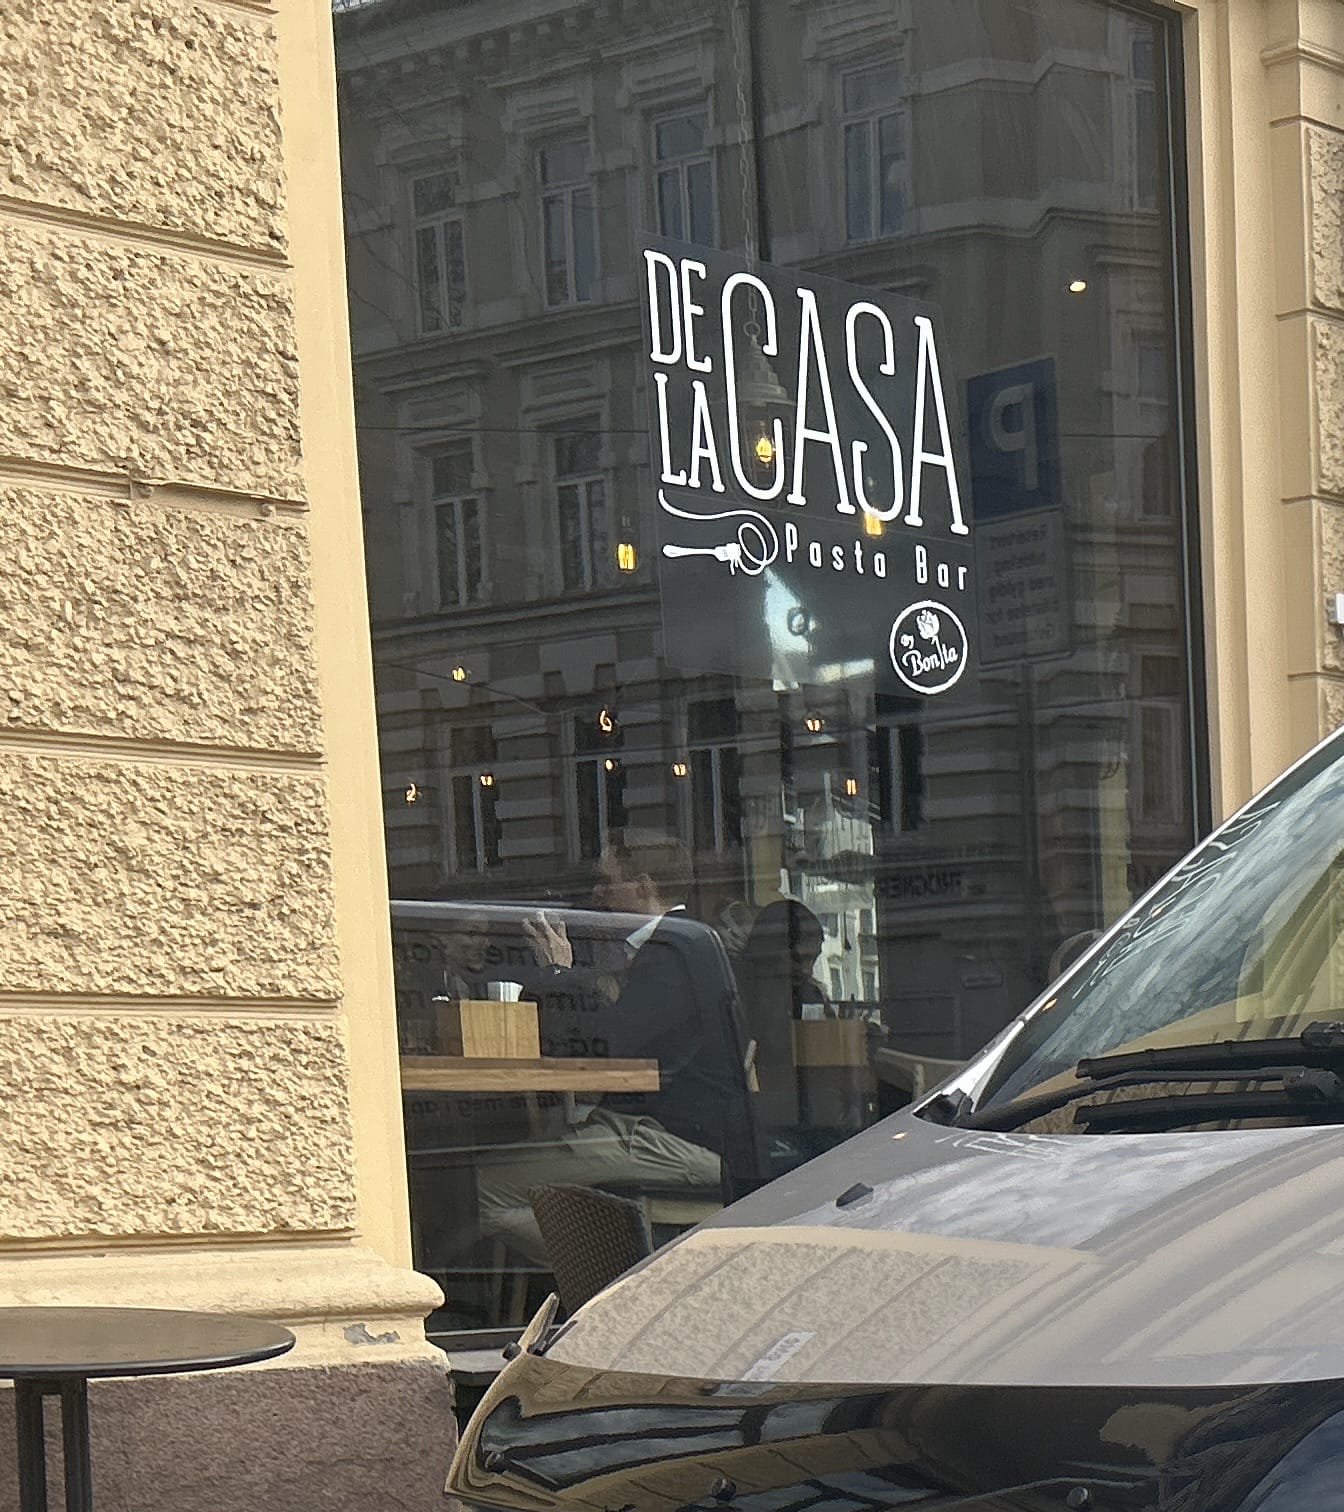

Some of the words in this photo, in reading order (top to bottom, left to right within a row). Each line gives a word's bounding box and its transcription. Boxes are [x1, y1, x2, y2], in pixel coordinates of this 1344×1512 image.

[644, 249, 712, 372] DE
[654, 373, 725, 492] LA
[721, 273, 968, 534] CASA
[785, 523, 886, 578] Pasta
[915, 545, 968, 591] Bar
